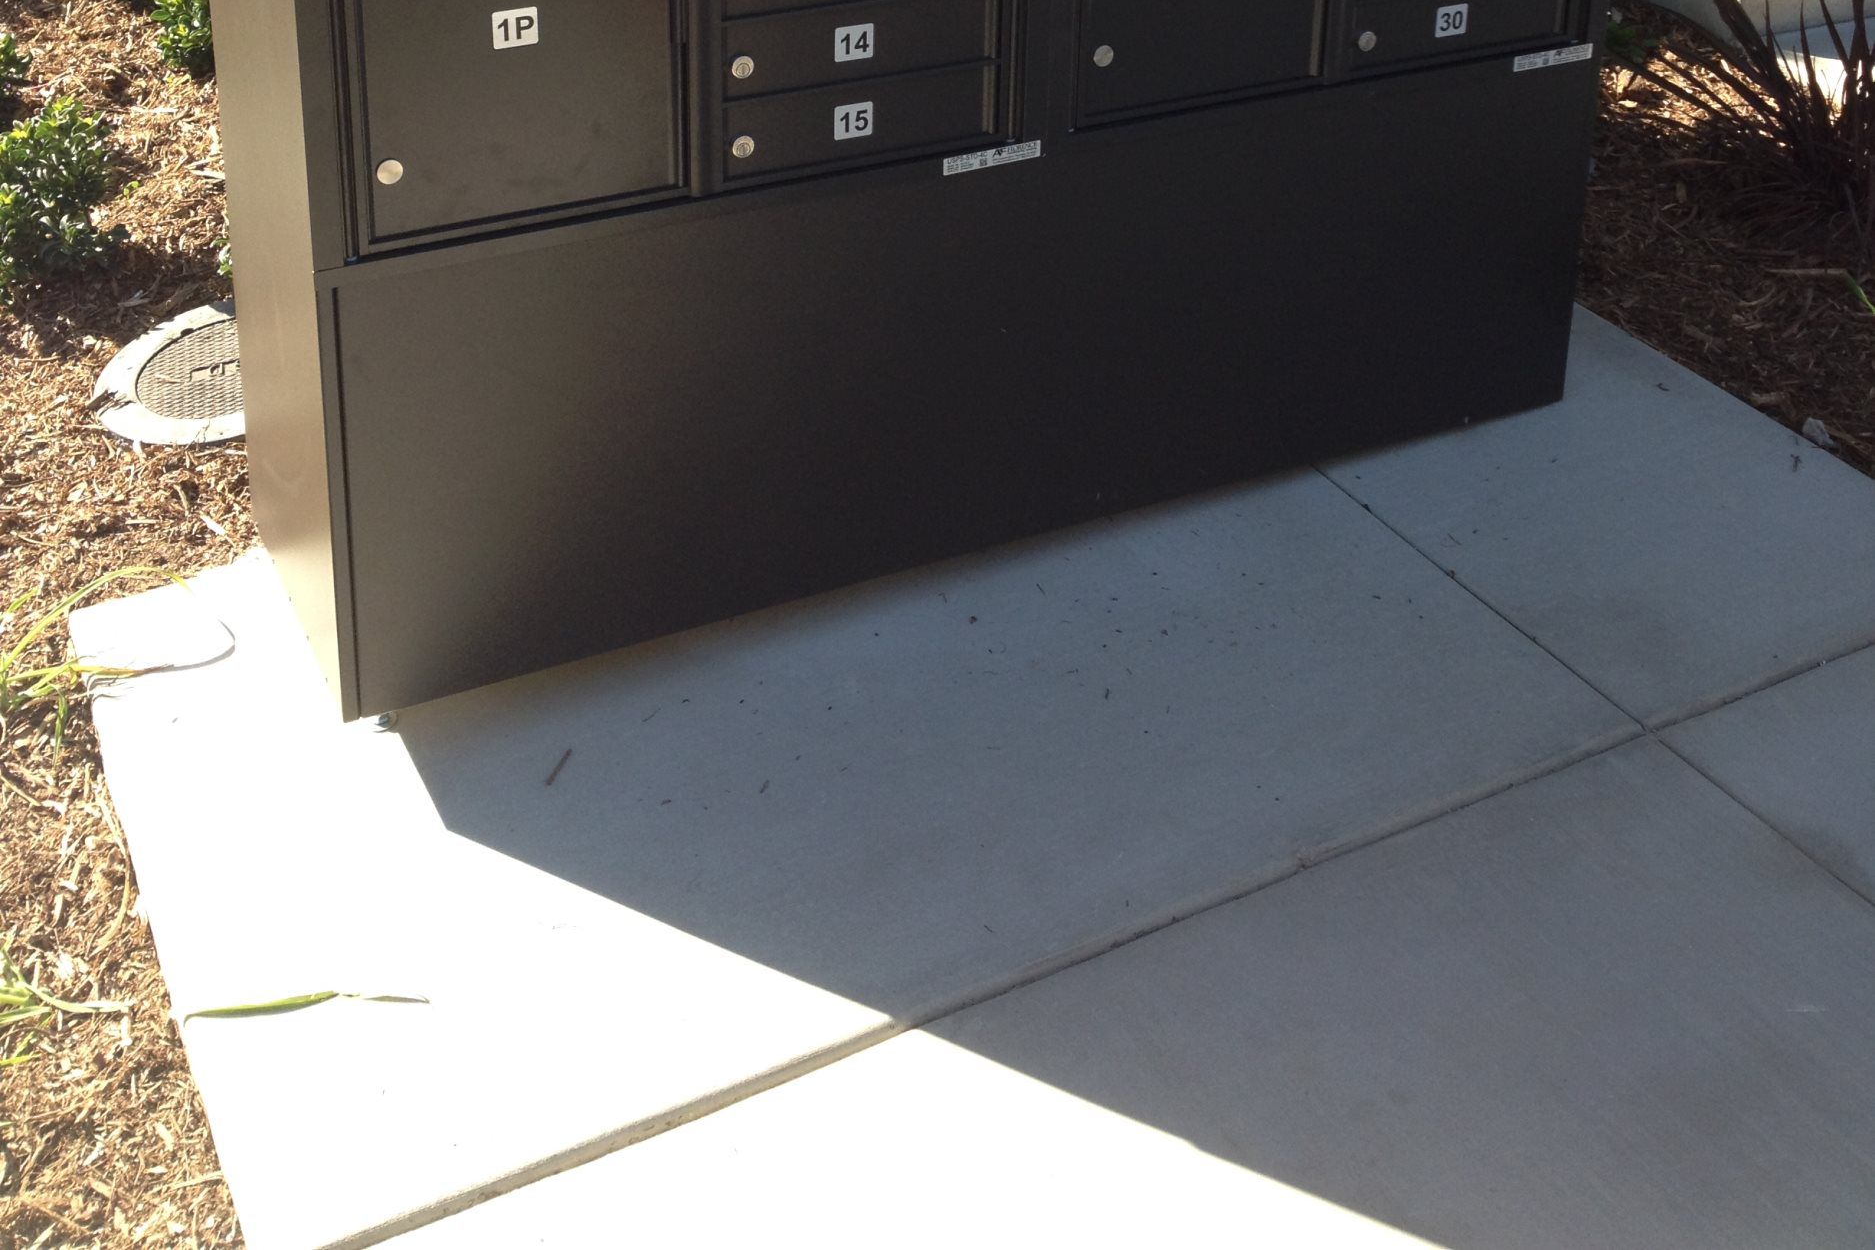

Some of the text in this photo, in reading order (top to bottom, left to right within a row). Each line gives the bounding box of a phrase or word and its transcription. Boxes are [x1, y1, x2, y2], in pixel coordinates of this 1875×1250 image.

[497, 15, 535, 42] 1P
[1439, 10, 1464, 32] 30
[840, 30, 870, 55] 14
[839, 109, 869, 134] 15
